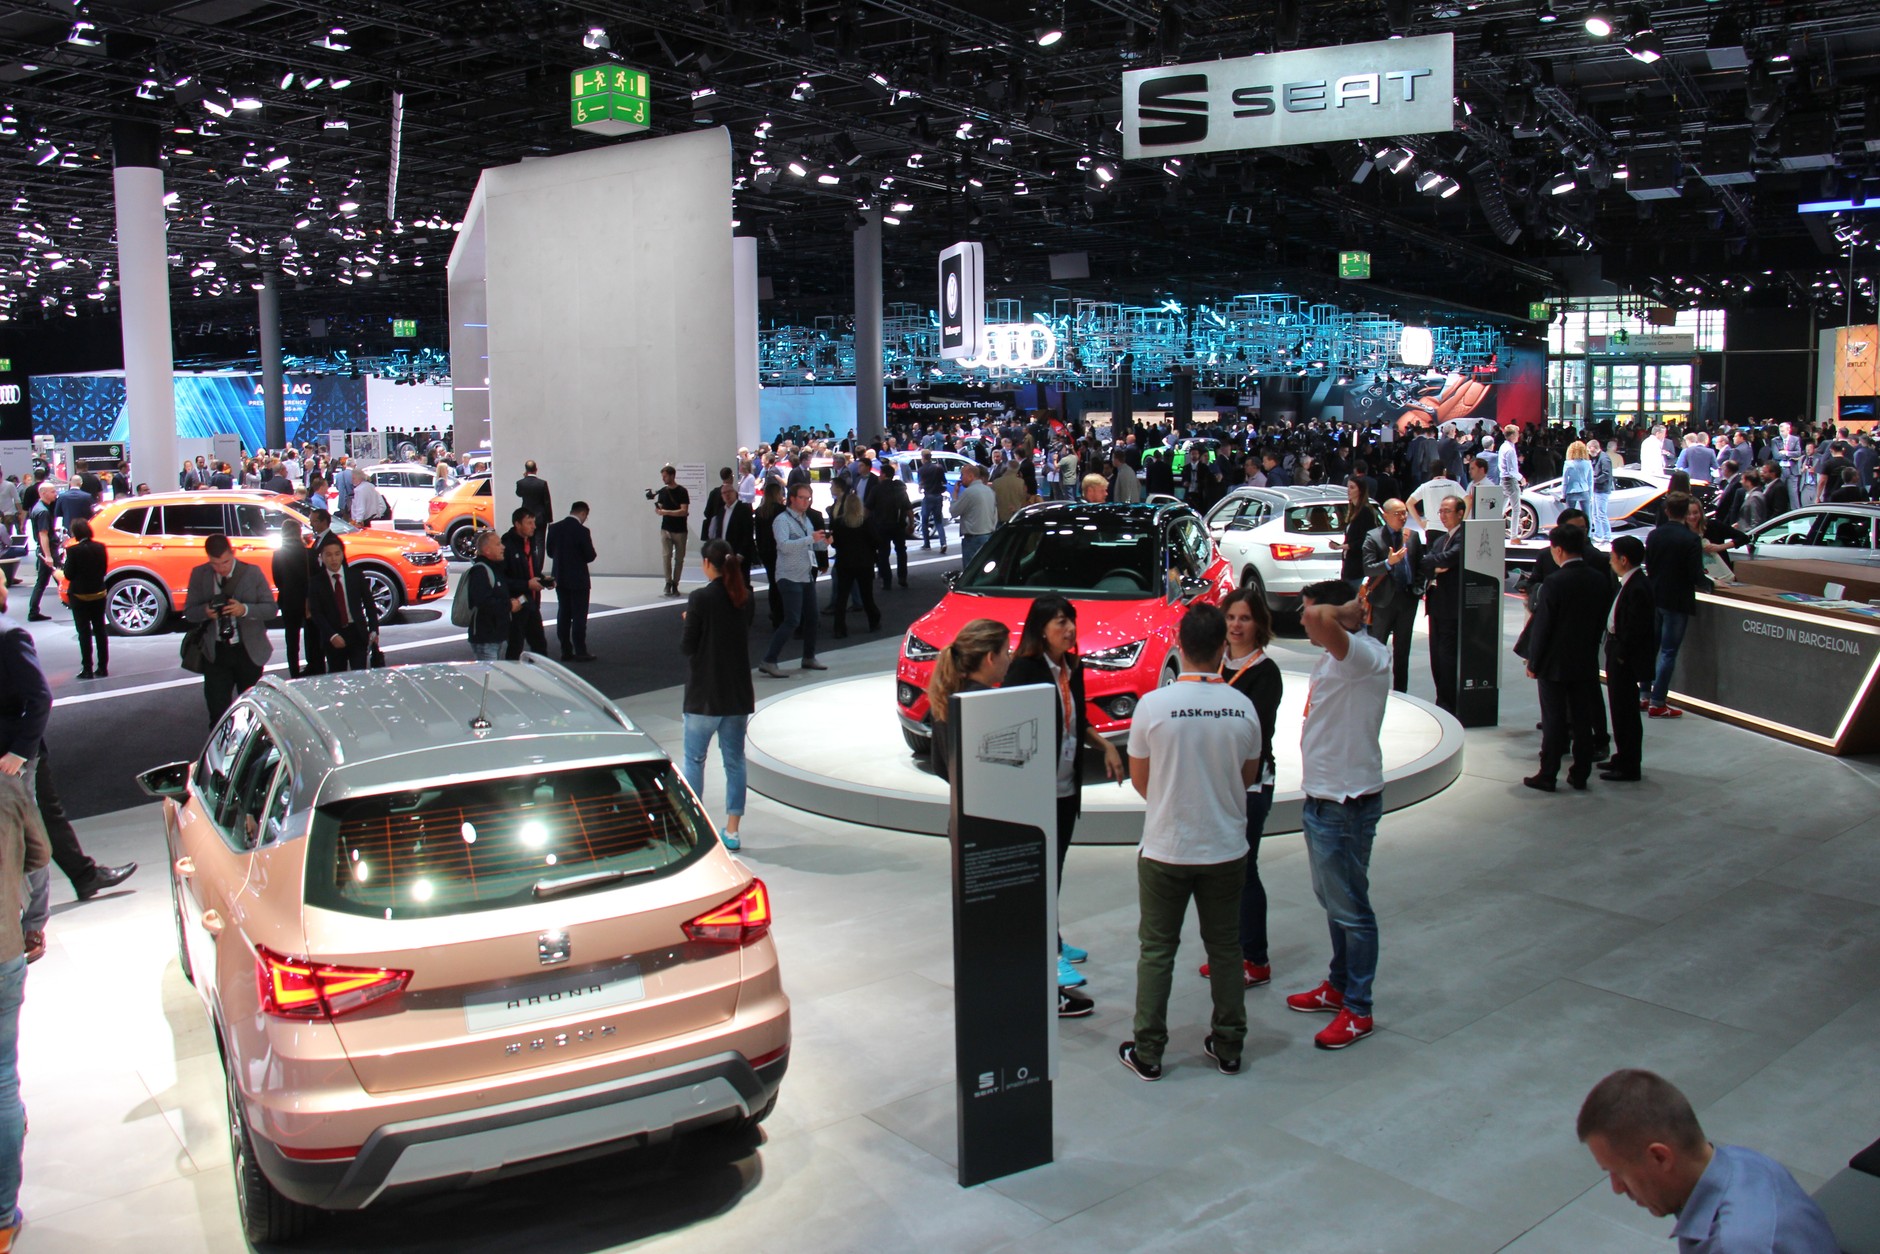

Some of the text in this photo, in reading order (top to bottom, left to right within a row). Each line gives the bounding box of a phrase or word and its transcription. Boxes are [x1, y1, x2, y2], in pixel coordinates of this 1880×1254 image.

[1232, 68, 1432, 118] SEAT
[254, 383, 311, 395] AI AG
[890, 402, 908, 410] Audi
[910, 402, 949, 410] Vorsprung
[1742, 619, 1860, 655] CREATED IN BARCELONA
[1171, 708, 1245, 718] #ASKmySEAT
[507, 984, 602, 1009] ARONA
[974, 1087, 999, 1098] SEAT
